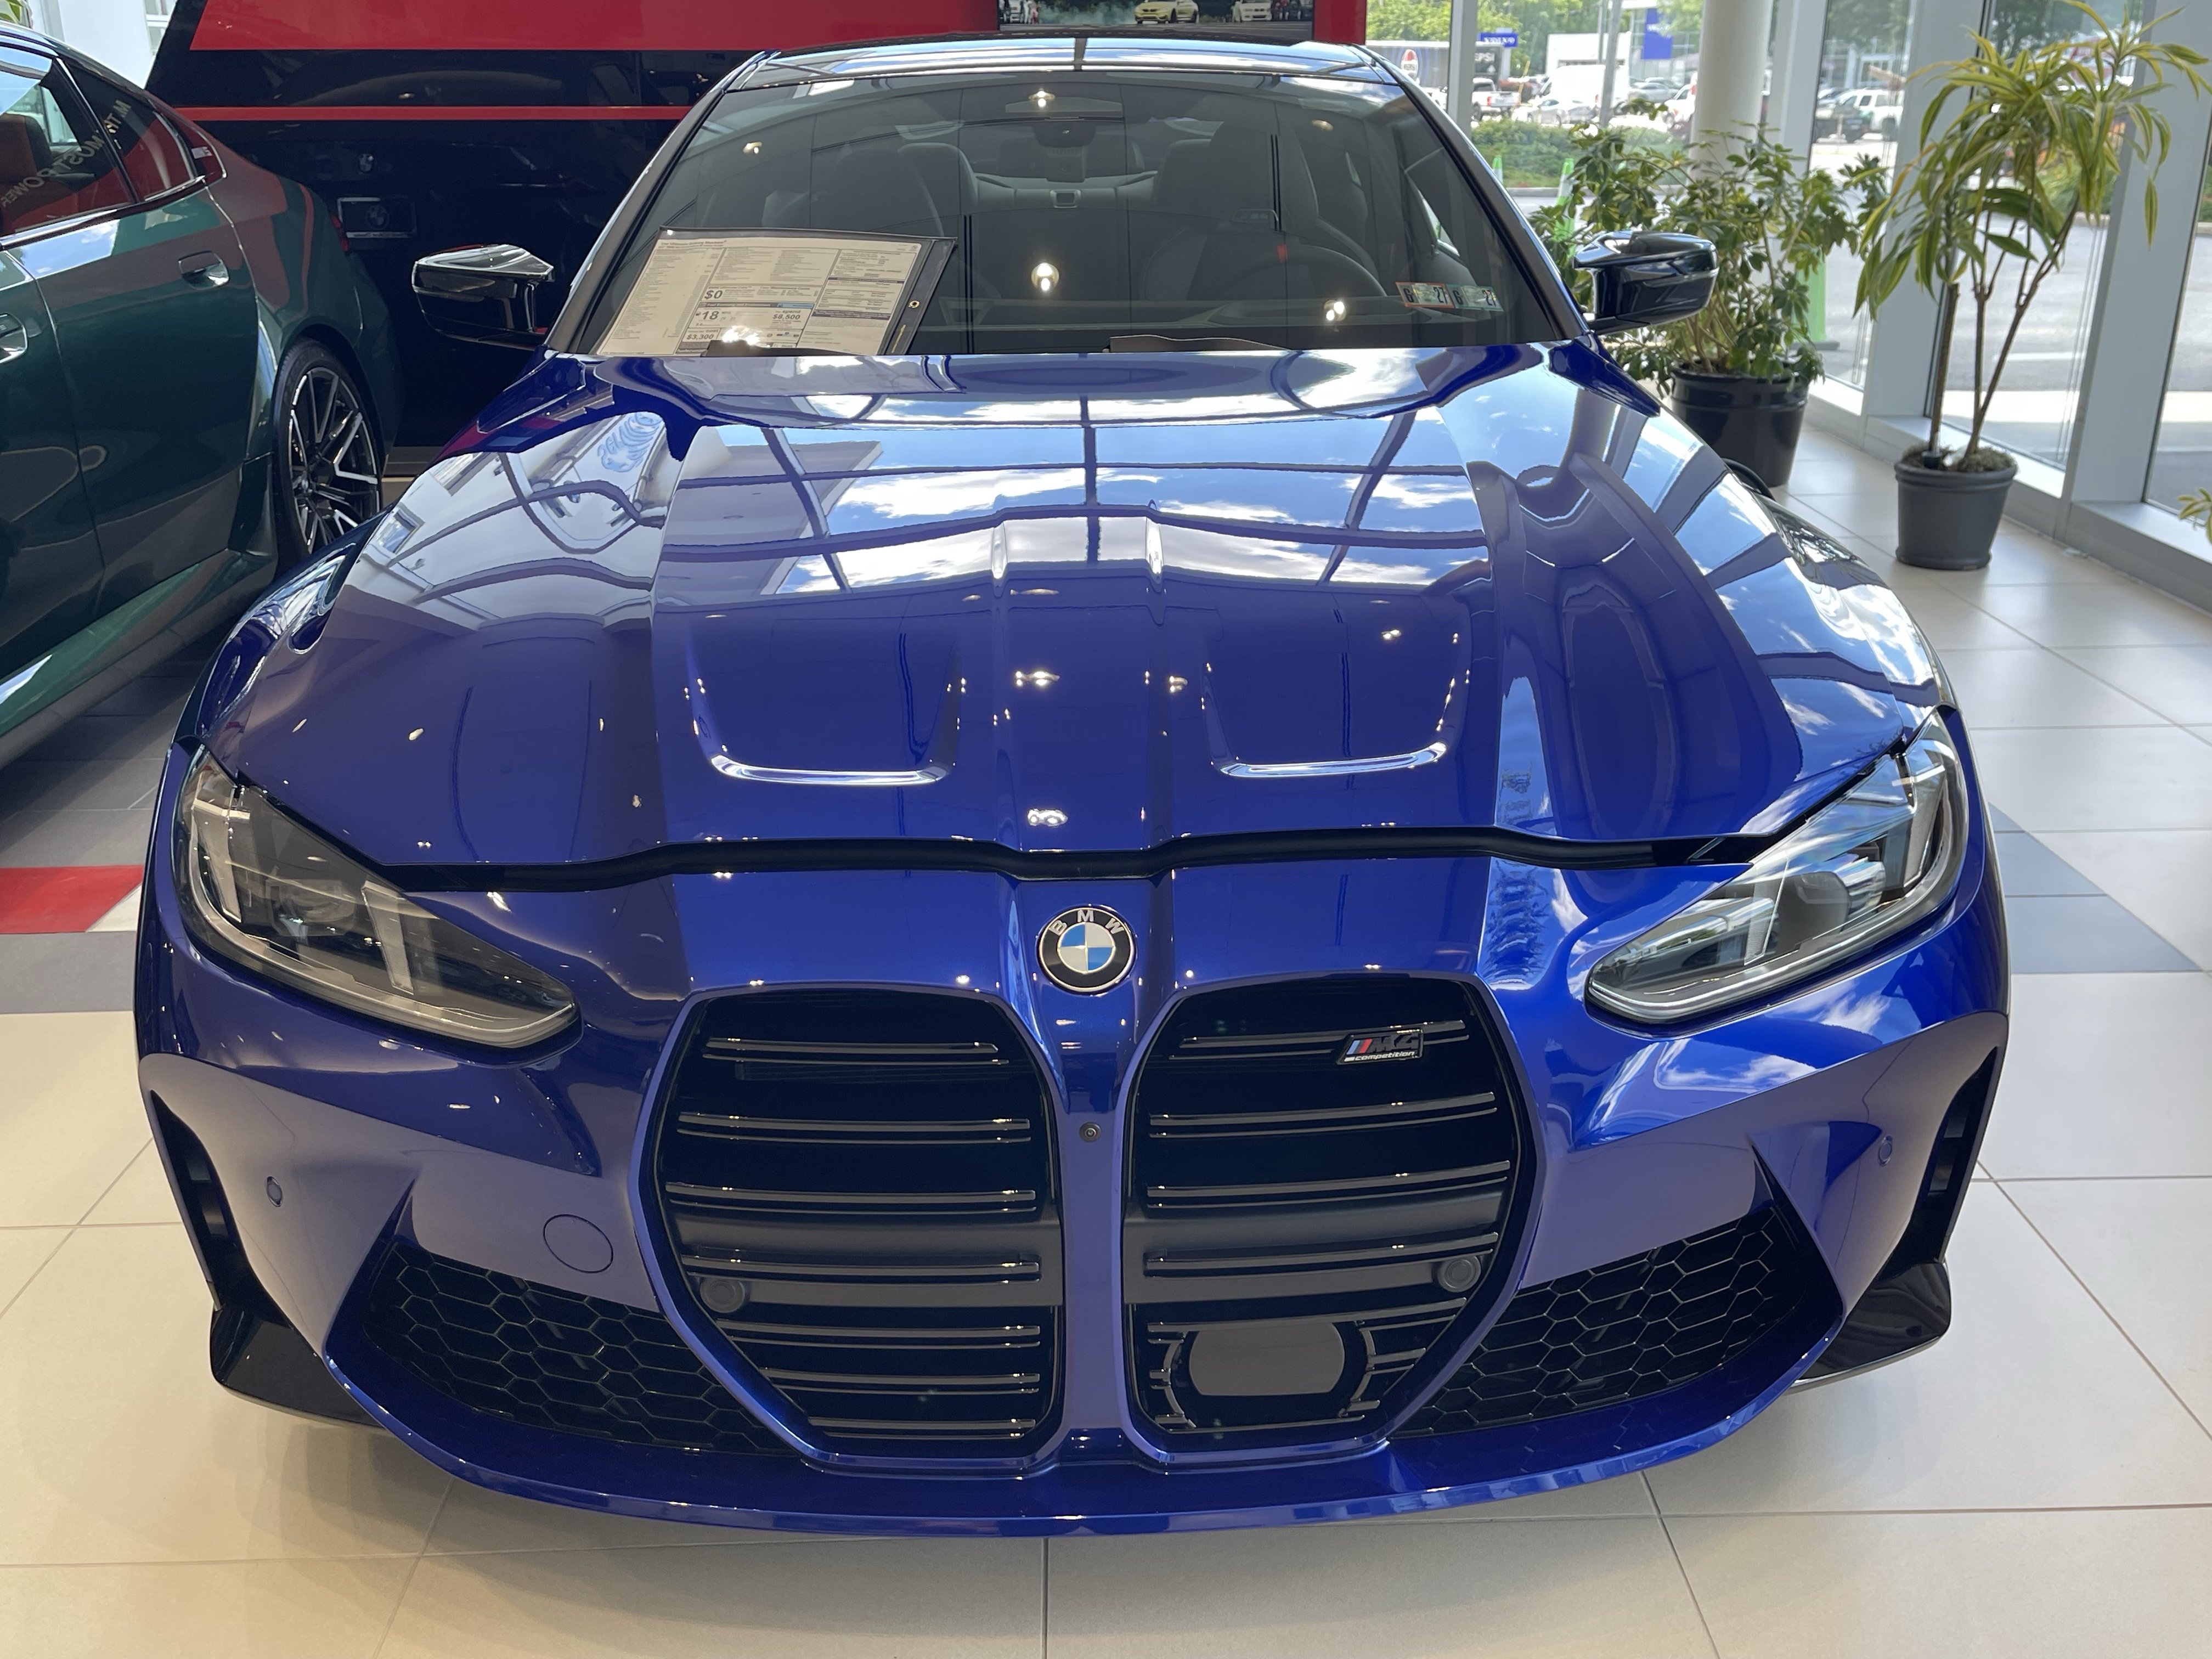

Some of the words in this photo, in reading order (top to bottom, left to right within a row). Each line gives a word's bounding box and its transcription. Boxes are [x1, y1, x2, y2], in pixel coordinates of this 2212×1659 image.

[704, 290, 723, 300] $0
[1403, 287, 1414, 303] 6
[1433, 286, 1448, 304] 27
[1452, 290, 1464, 306] 6
[702, 311, 719, 320] 18
[1048, 910, 1124, 936] BMW
[1367, 1033, 1419, 1053] M4
[1355, 1051, 1415, 1060] competition
